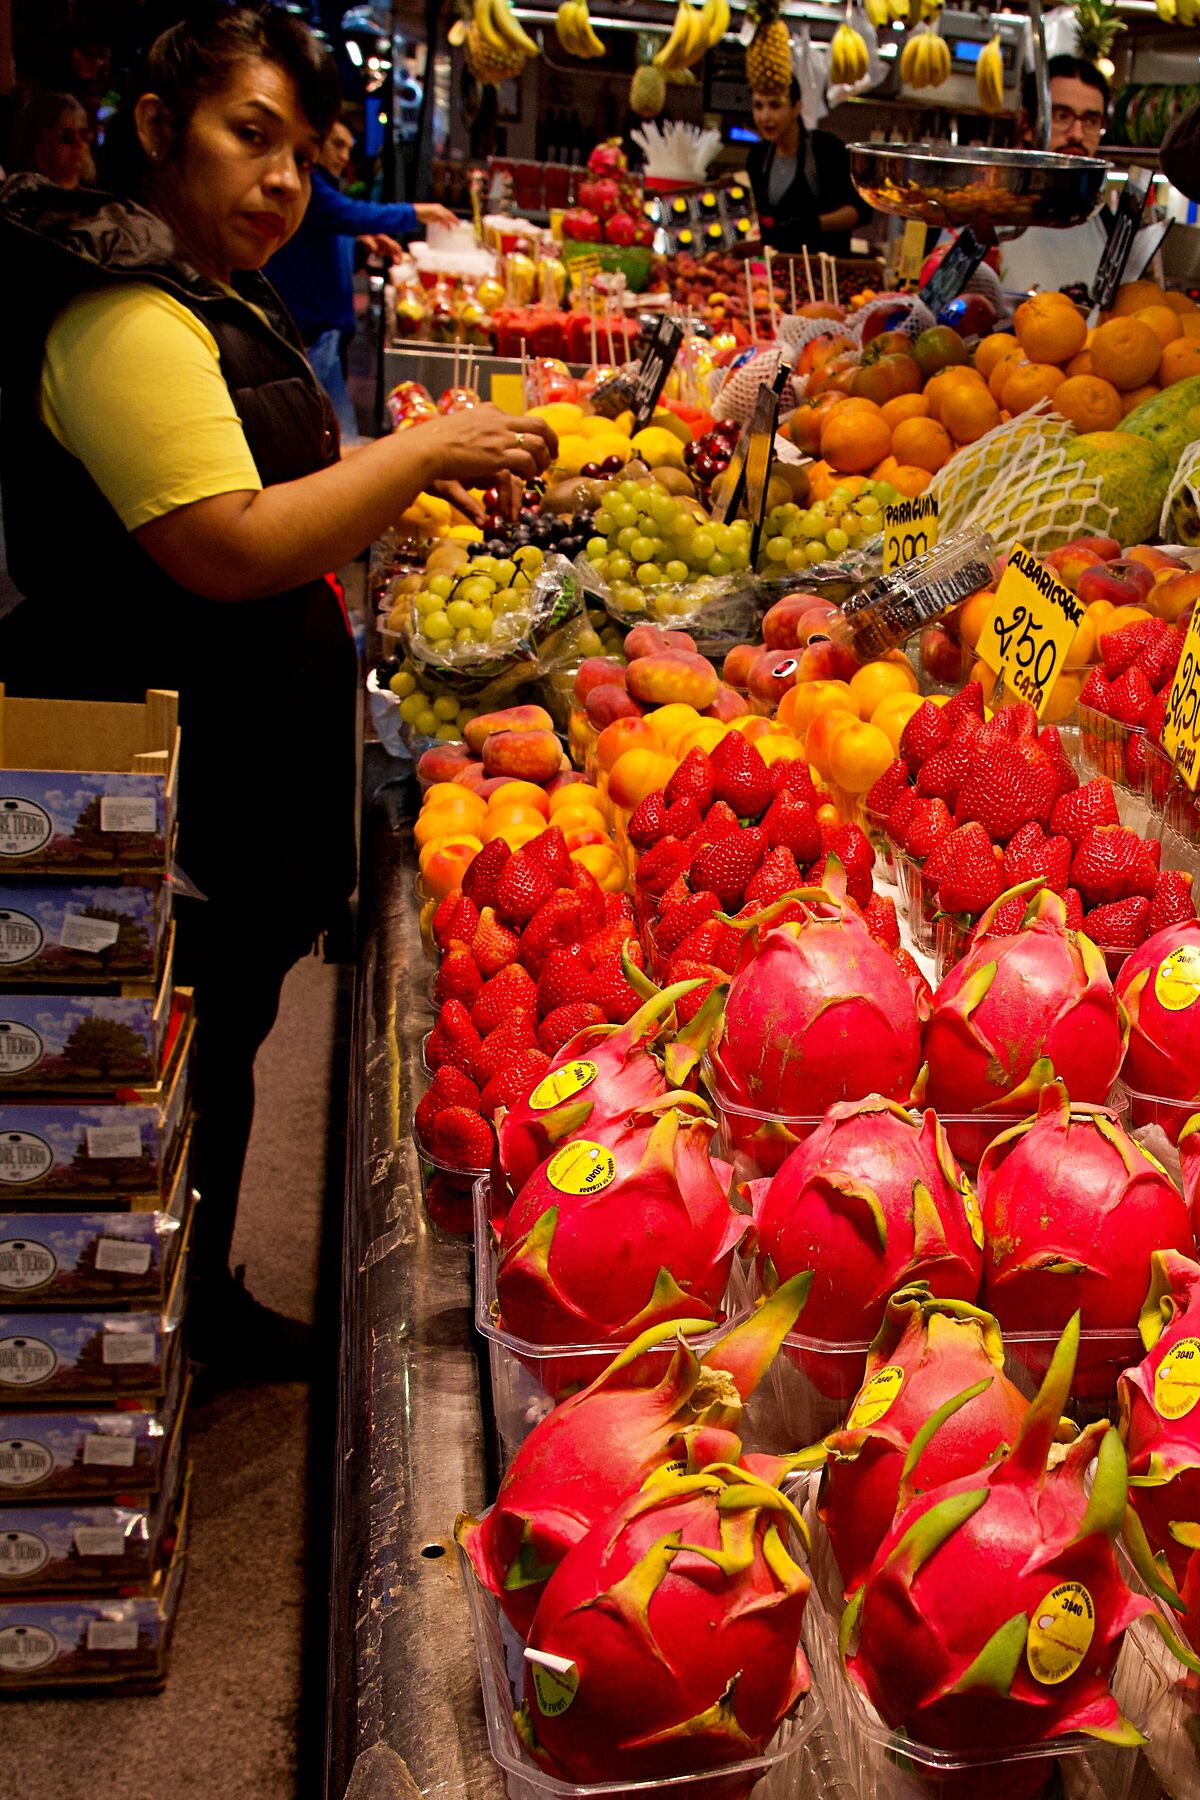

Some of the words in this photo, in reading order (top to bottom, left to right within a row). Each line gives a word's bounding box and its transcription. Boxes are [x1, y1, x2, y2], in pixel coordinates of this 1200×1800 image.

[1008, 550, 1084, 628] ALBARICOQUE
[1014, 669, 1043, 710] CAJA
[585, 1164, 605, 1183] 3040
[1175, 1350, 1194, 1359] 3040
[1062, 1598, 1083, 1617] 3040
